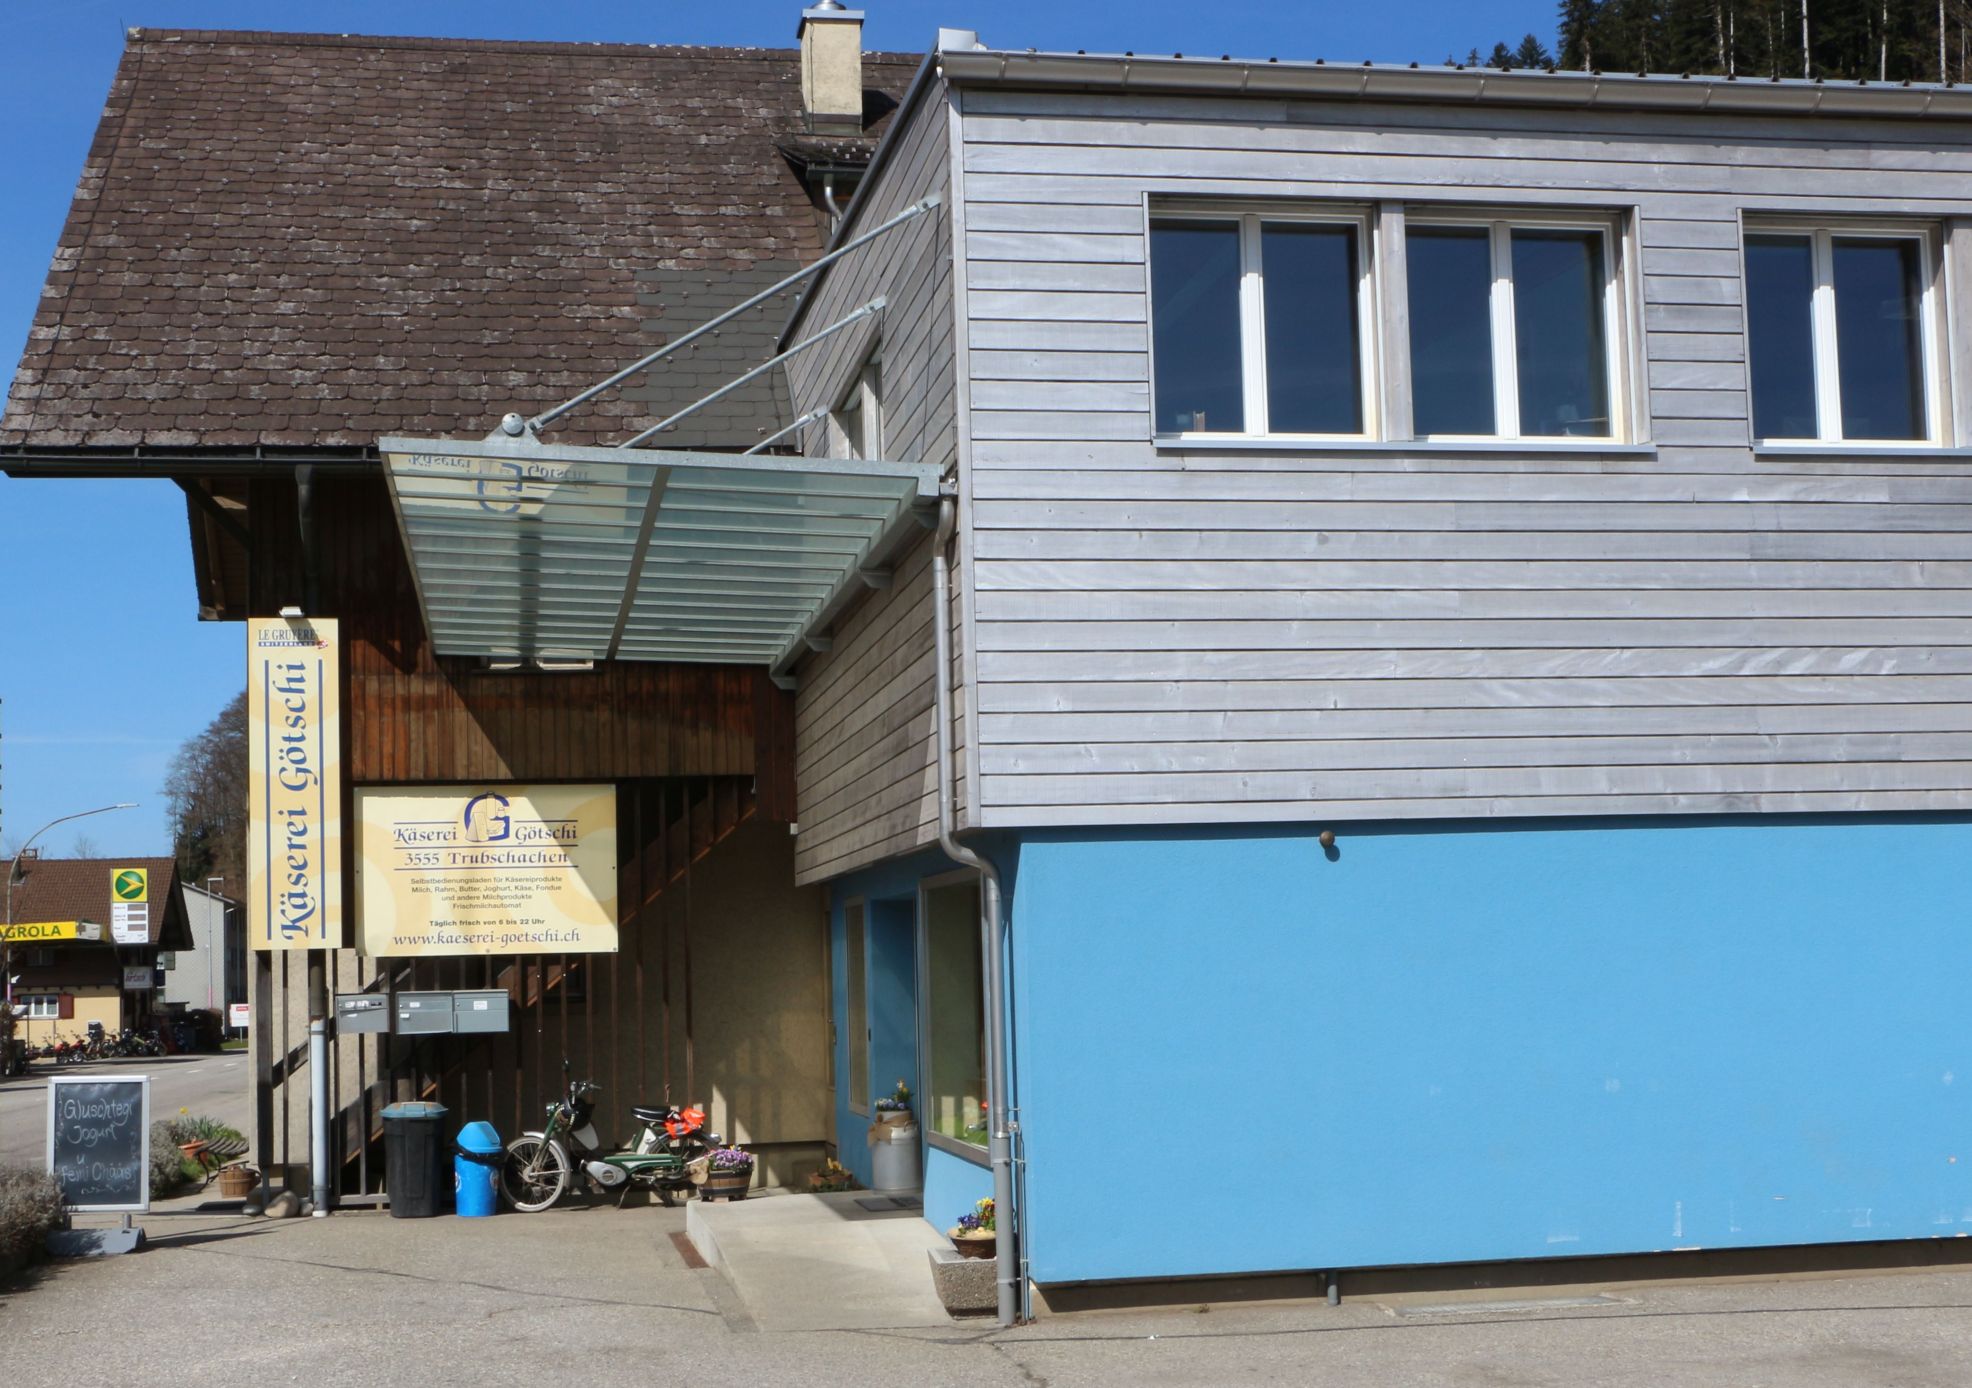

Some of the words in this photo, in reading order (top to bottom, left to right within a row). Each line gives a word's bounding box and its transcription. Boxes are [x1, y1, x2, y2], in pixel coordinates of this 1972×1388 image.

[258, 629, 270, 641] LE
[273, 661, 318, 791] Götschi
[393, 827, 458, 845] Käserei
[514, 824, 577, 845] Götschi
[405, 852, 440, 866] 3555
[447, 850, 568, 865] Trubschachen
[277, 806, 316, 941] Käserei
[411, 877, 492, 886] Selbstbedienungsladen
[505, 875, 562, 884] Käsereiprodukte
[484, 885, 512, 893] Joghurt,
[452, 902, 522, 910] Frischmilchautomat
[0, 925, 62, 939] GROLA
[393, 928, 581, 948] www.kaeserei-goetschi.ch
